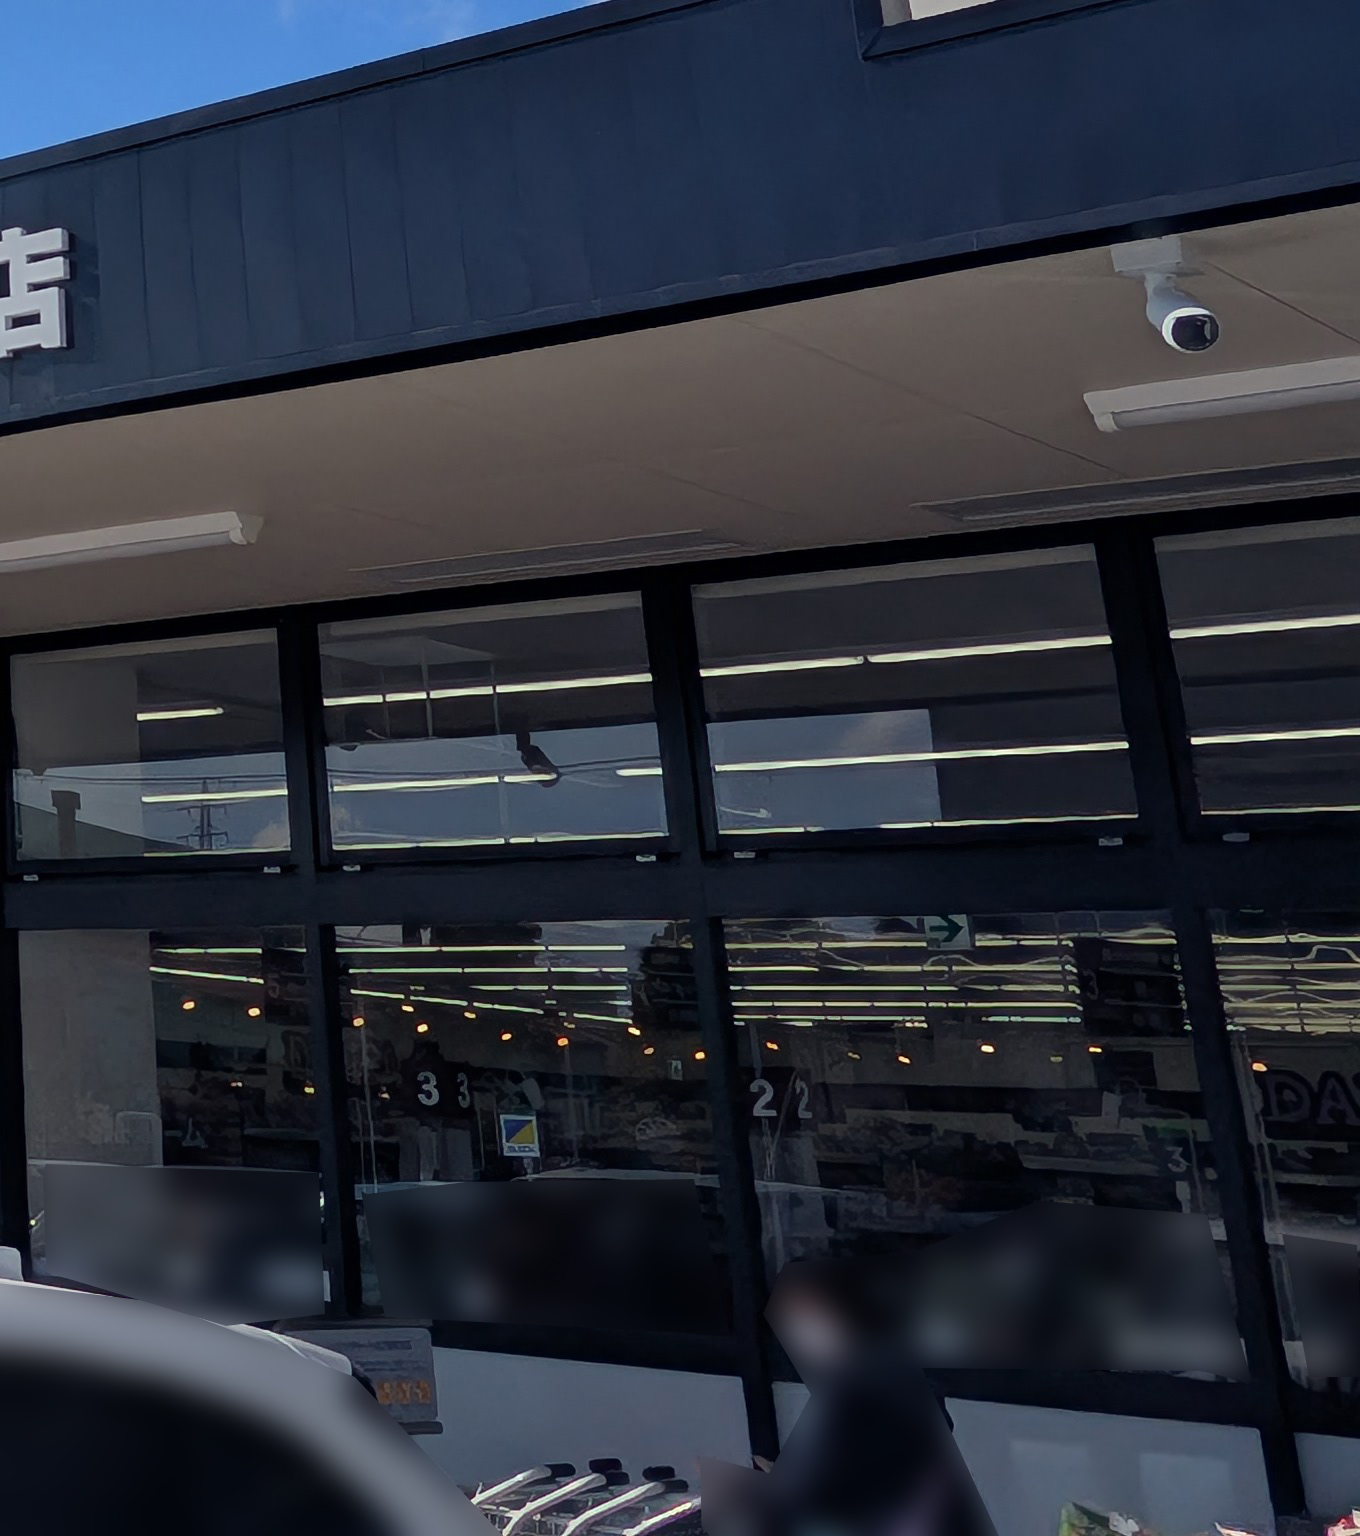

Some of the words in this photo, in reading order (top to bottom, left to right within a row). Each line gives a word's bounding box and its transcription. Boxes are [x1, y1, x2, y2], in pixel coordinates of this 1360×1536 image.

[416, 1071, 440, 1107] 3
[456, 1072, 471, 1109] 3
[749, 1078, 779, 1117] 2
[795, 1076, 814, 1119] 2
[1264, 1073, 1360, 1126] DA
